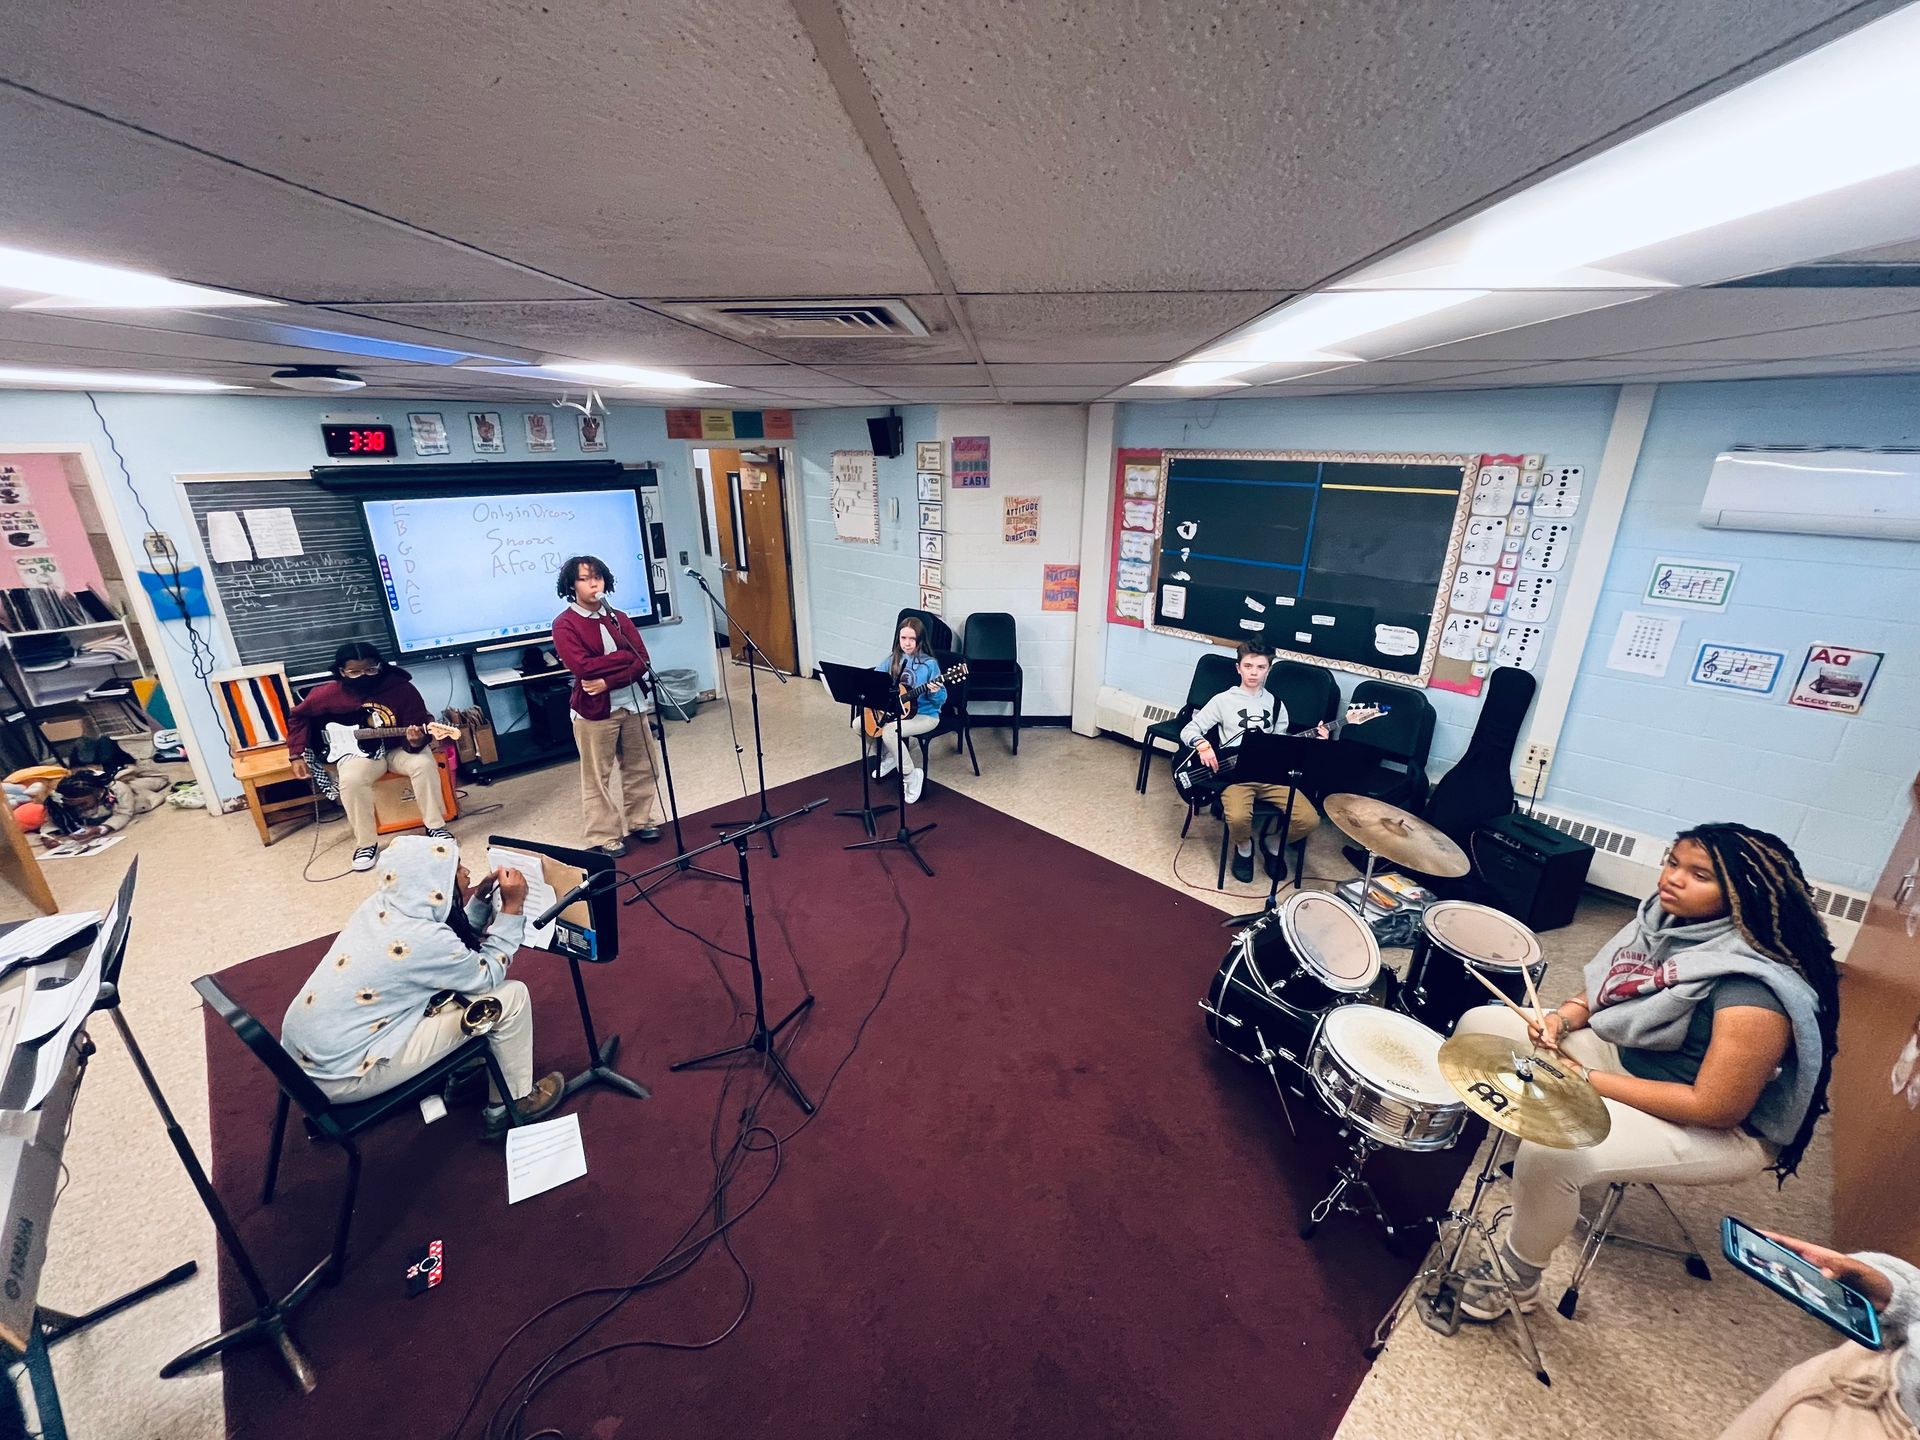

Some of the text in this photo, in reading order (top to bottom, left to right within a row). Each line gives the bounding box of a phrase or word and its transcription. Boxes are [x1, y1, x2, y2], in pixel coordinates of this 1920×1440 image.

[963, 476, 987, 486] EASY
[1481, 473, 1491, 486] D
[1542, 473, 1553, 486] D
[392, 503, 410, 516] E
[473, 503, 513, 522] Only
[1006, 503, 1038, 515] ATTITUDE
[394, 520, 407, 536] B
[1470, 523, 1481, 535] C
[1532, 528, 1543, 540] C
[486, 528, 555, 554] Snooze
[1006, 529, 1036, 542] DIRECTION
[231, 559, 283, 574] Lunch
[405, 560, 416, 573] D
[492, 549, 536, 577] Afro
[1459, 571, 1469, 583] B
[406, 579, 420, 594] A
[1518, 580, 1528, 592] E
[408, 595, 422, 614] E
[1448, 620, 1458, 632] A
[1508, 628, 1518, 639] F
[1811, 648, 1850, 666] Aa
[1796, 695, 1855, 711] Accordion
[1620, 950, 1647, 962] MOUNT
